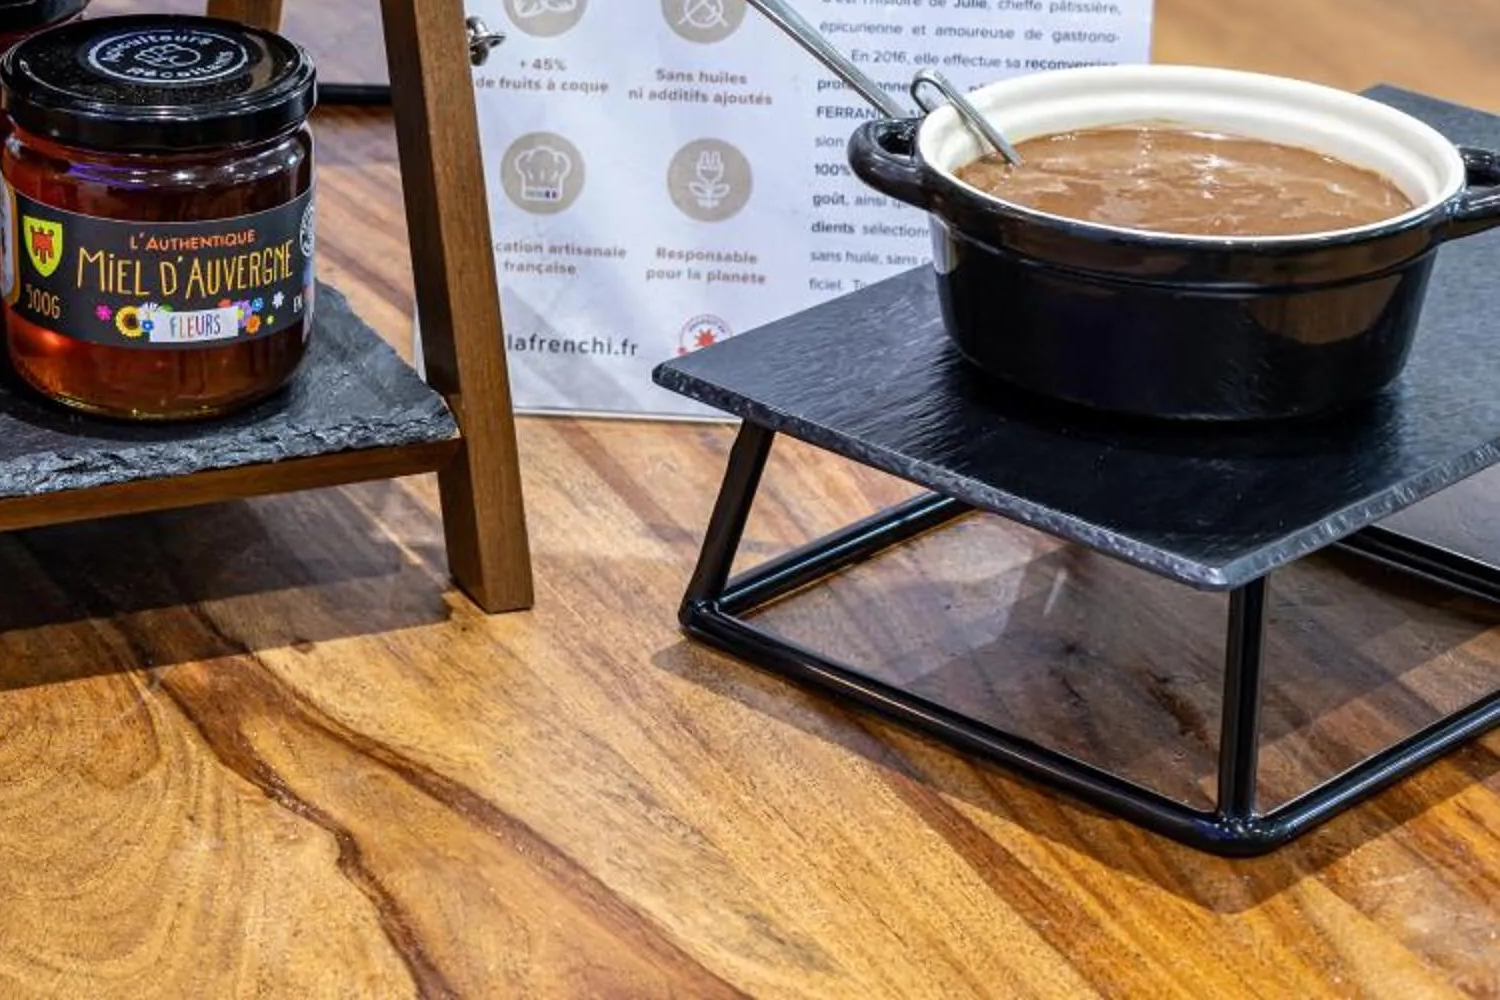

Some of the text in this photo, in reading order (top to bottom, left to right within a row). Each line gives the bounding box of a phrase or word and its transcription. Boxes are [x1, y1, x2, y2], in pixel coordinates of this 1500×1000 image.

[1049, 0, 1121, 15] pâtissière,
[820, 21, 903, 35] épicurienne
[912, 23, 926, 36] et
[935, 26, 1015, 39] amoureuse
[1024, 28, 1043, 40] de
[851, 50, 869, 63] En
[873, 51, 910, 65] 2016,
[914, 52, 939, 65] elle
[943, 53, 1000, 68] effectue
[1005, 57, 1021, 68] sa
[476, 76, 609, 95] de fruits coque
[655, 69, 747, 84] Sans huiles
[628, 88, 773, 106] ni additifs ajoutés
[549, 242, 627, 258] artisanale
[655, 247, 757, 264] Responsable
[810, 253, 842, 263] sans
[846, 251, 883, 265] huile,
[886, 254, 923, 265] sans
[159, 240, 293, 299] D'AUVERGNE
[504, 261, 578, 276] française
[646, 268, 766, 284] pour la planète
[26, 283, 60, 319] 500G
[170, 313, 221, 338] FLEURS
[508, 334, 639, 356] lafrenchi.fr
